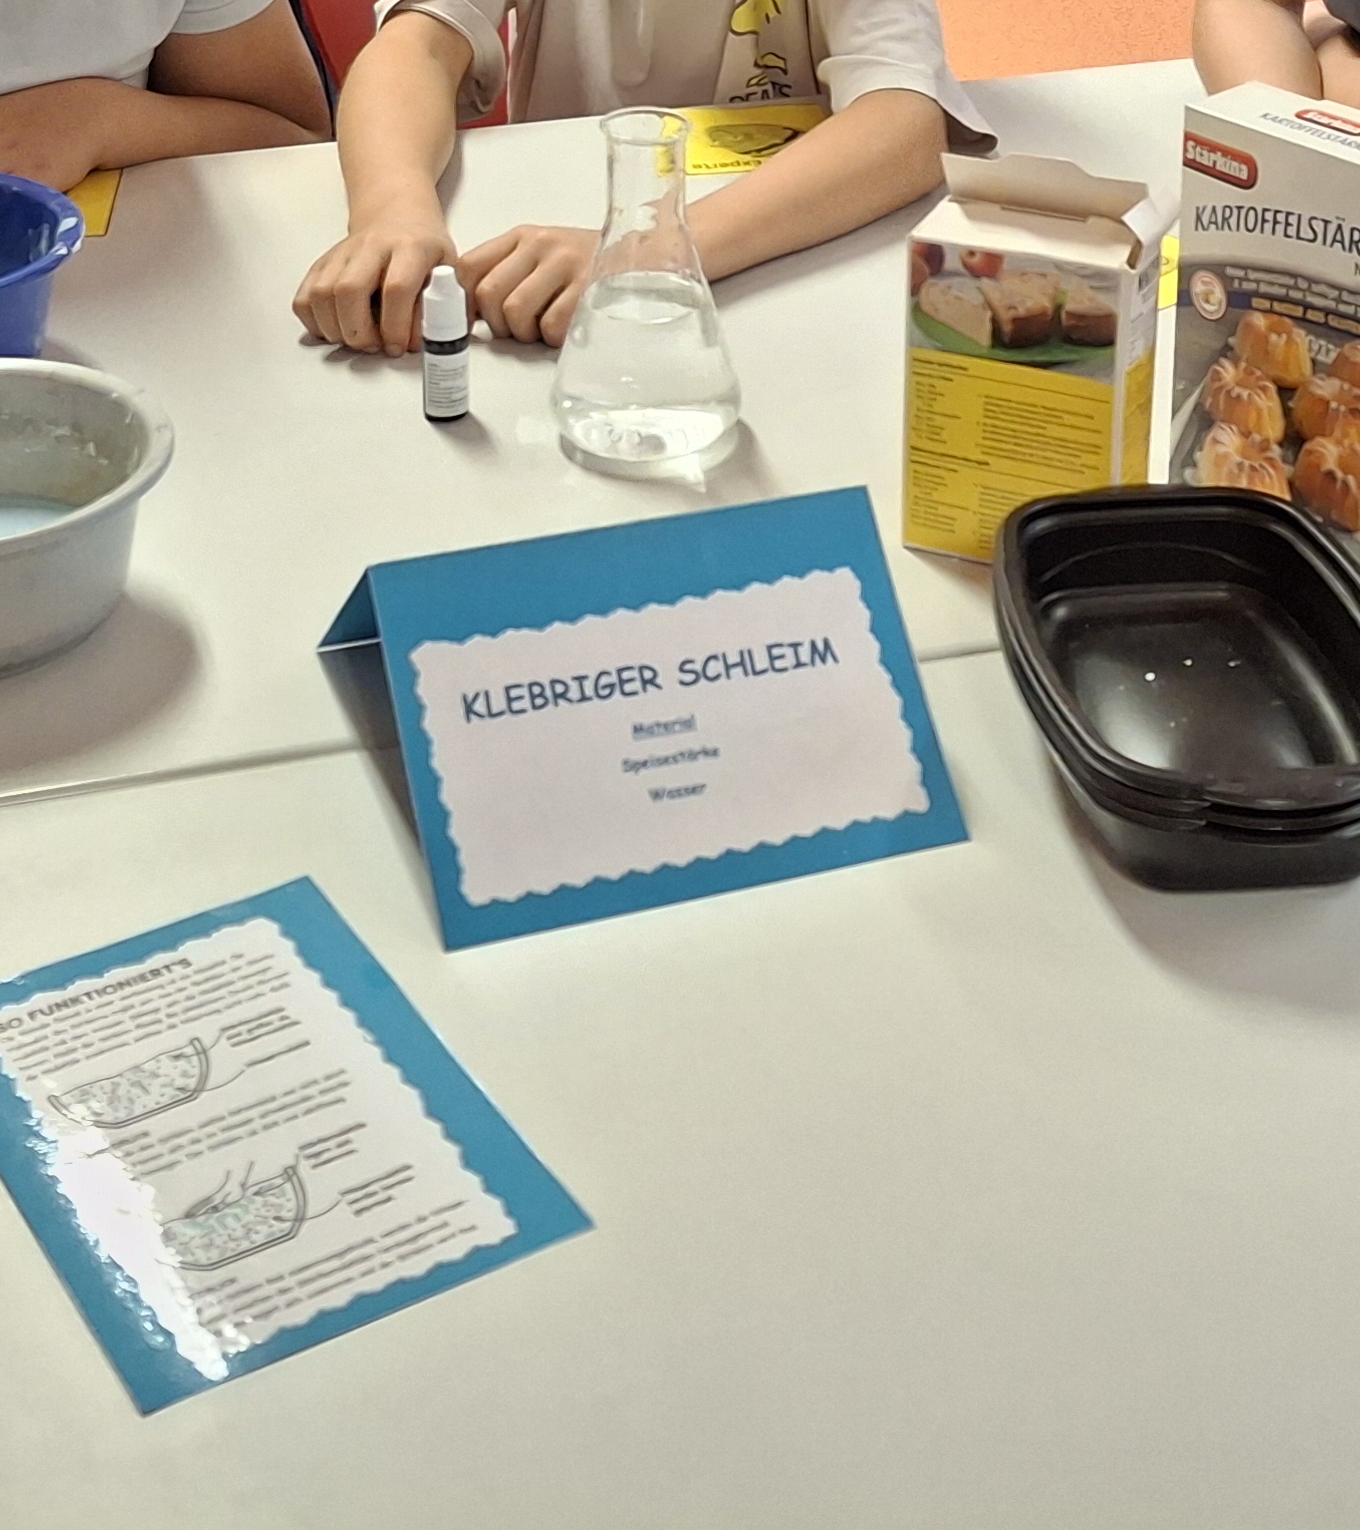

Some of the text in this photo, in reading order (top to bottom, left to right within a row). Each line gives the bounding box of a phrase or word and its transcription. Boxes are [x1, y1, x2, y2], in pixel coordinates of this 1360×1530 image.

[1185, 140, 1249, 181] Stärkina
[461, 636, 840, 723] KLEBRIGER SCHLEIM
[632, 714, 697, 740] Material
